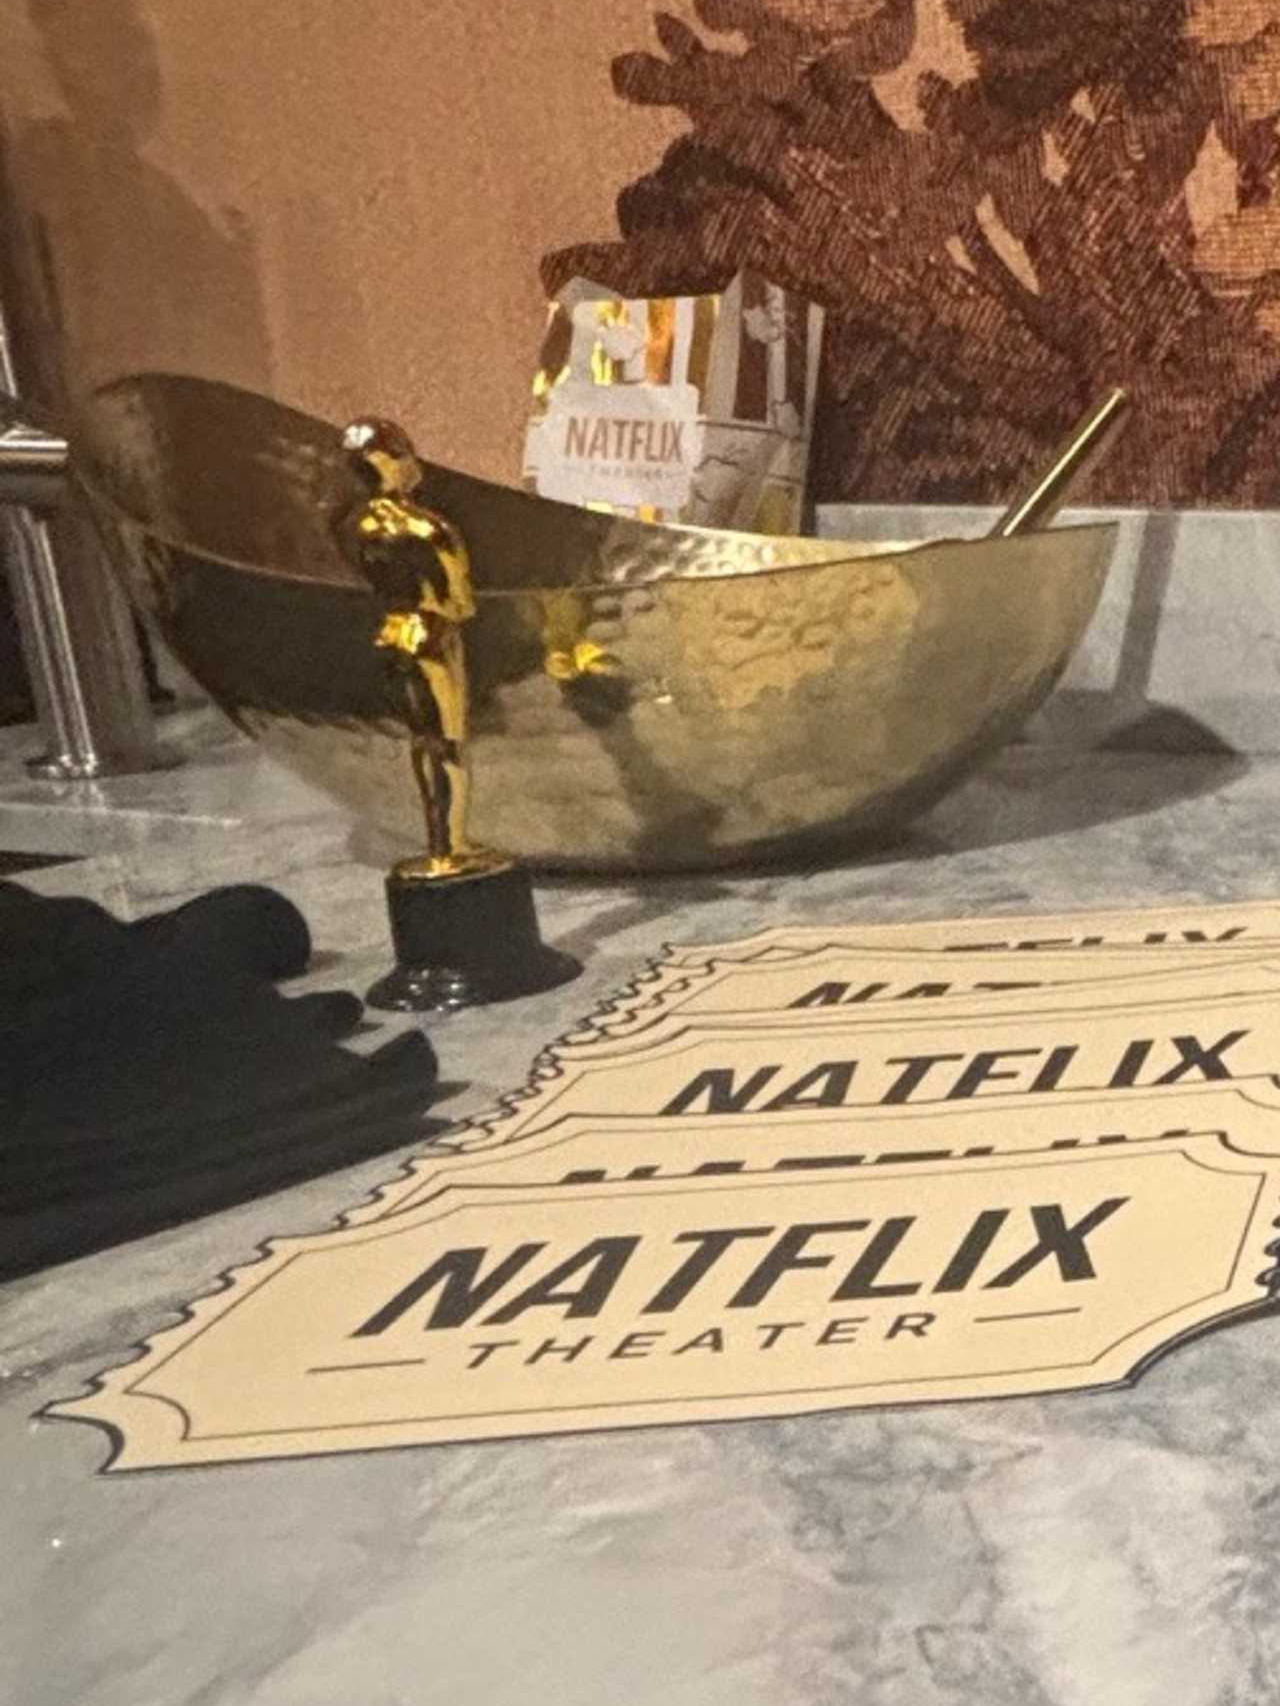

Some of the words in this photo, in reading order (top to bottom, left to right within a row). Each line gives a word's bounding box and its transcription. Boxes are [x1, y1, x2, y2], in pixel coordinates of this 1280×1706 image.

[565, 417, 684, 463] NATFLIX
[351, 1194, 1133, 1339] NATFLIX
[464, 1310, 938, 1372] THEATER
